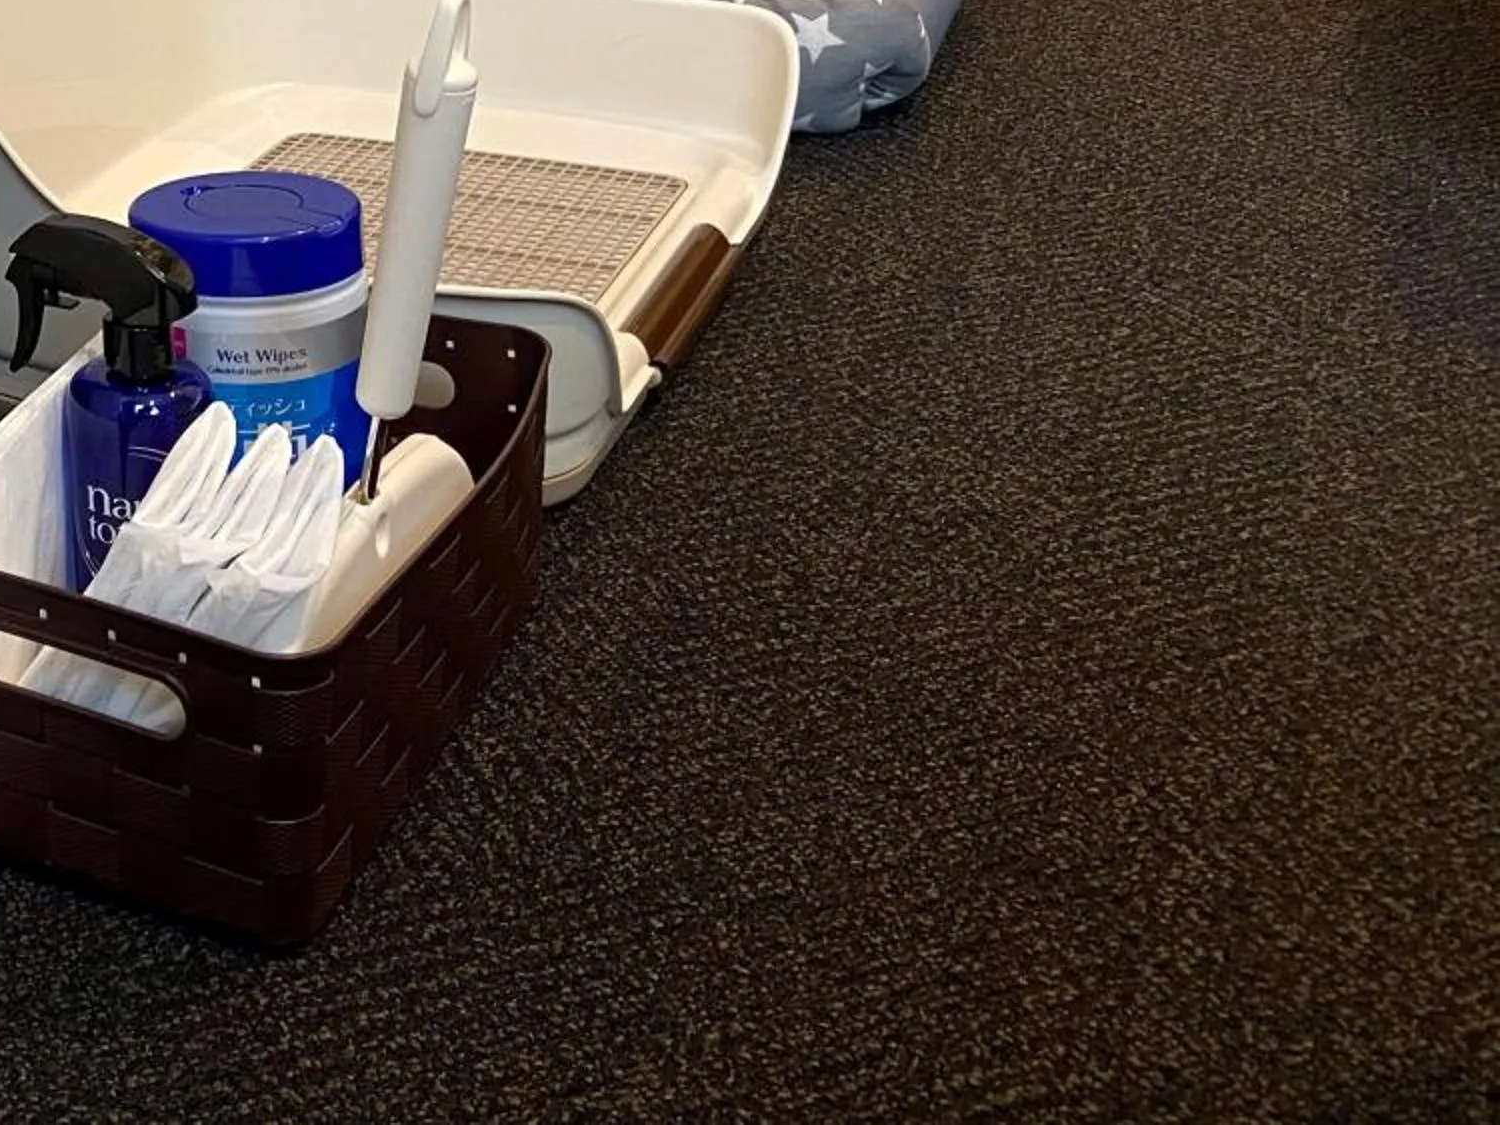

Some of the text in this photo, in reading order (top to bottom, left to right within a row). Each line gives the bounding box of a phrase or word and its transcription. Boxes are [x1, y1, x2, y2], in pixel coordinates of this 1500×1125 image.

[216, 348, 308, 367] Wet Wipes
[87, 515, 124, 544] to
